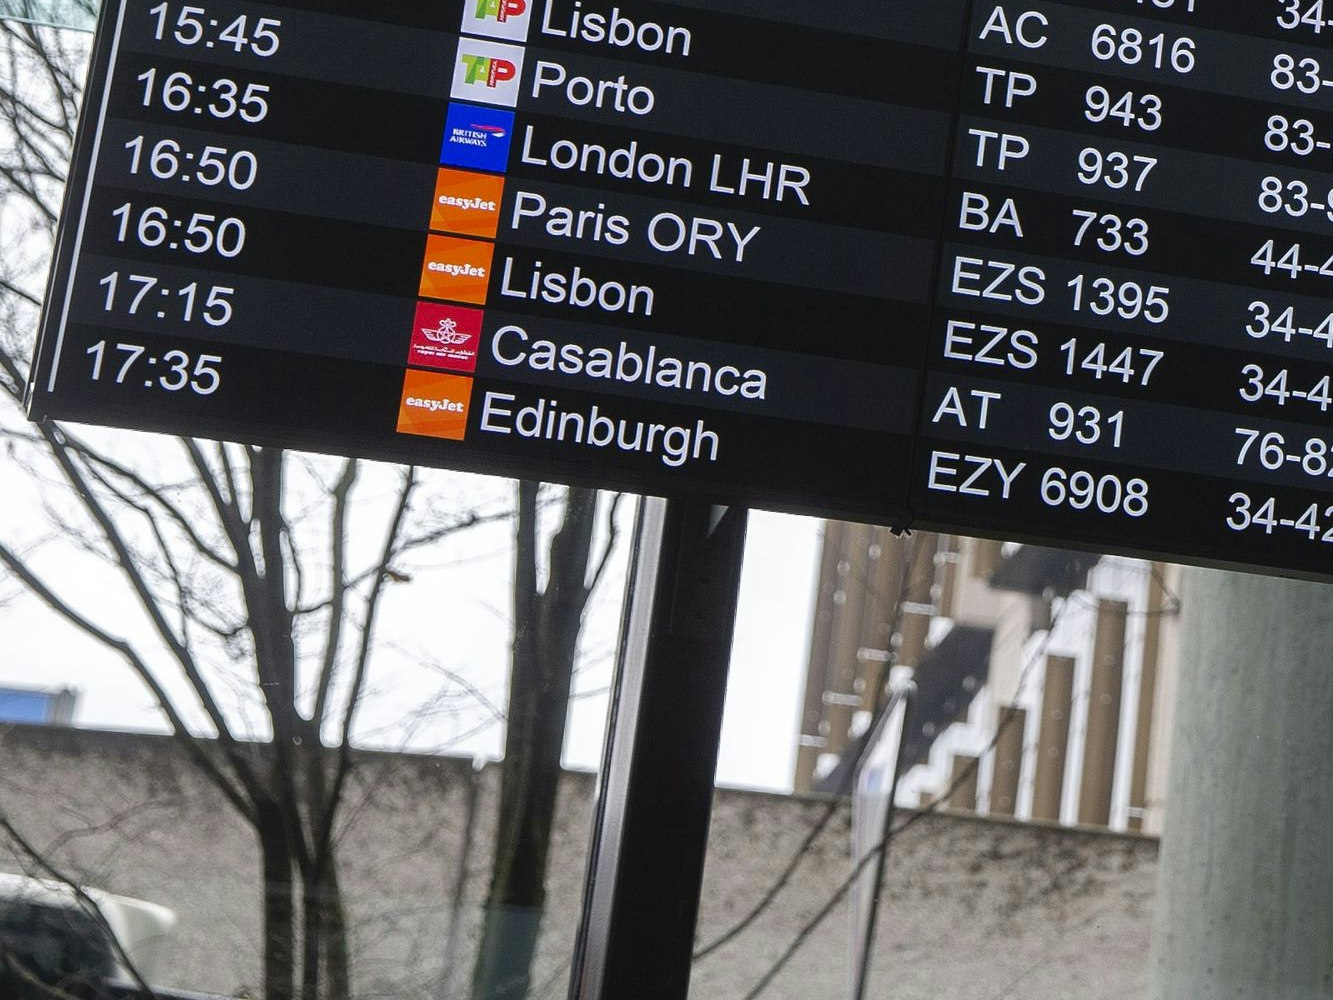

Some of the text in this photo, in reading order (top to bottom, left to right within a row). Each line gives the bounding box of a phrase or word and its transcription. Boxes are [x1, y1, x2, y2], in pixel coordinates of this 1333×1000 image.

[150, 2, 281, 56] 15:45
[532, 61, 654, 114] Porto
[969, 129, 1029, 170] TP
[1078, 148, 1157, 191] 937
[976, 66, 1036, 107] TP
[1085, 86, 1161, 130] 943
[979, 6, 1048, 48] AC
[1092, 24, 1195, 73] 6816
[126, 136, 257, 189] 16:50
[512, 192, 629, 244] Paris
[648, 213, 760, 262] ORY
[952, 256, 1045, 304] EZS
[1068, 275, 1169, 323] 1395
[138, 68, 269, 122] 16:35
[522, 125, 692, 187] London
[710, 154, 810, 205] LHR
[960, 192, 1023, 237] BA
[1073, 210, 1148, 255] 733
[87, 341, 221, 394] 17:35
[481, 392, 718, 466] Edinburgh
[928, 451, 1026, 498] EZY
[1041, 467, 1148, 516] 6908
[100, 272, 234, 326] 17:15
[492, 326, 766, 399] Casablanca
[933, 387, 1001, 429] AT
[1049, 402, 1123, 447] 931
